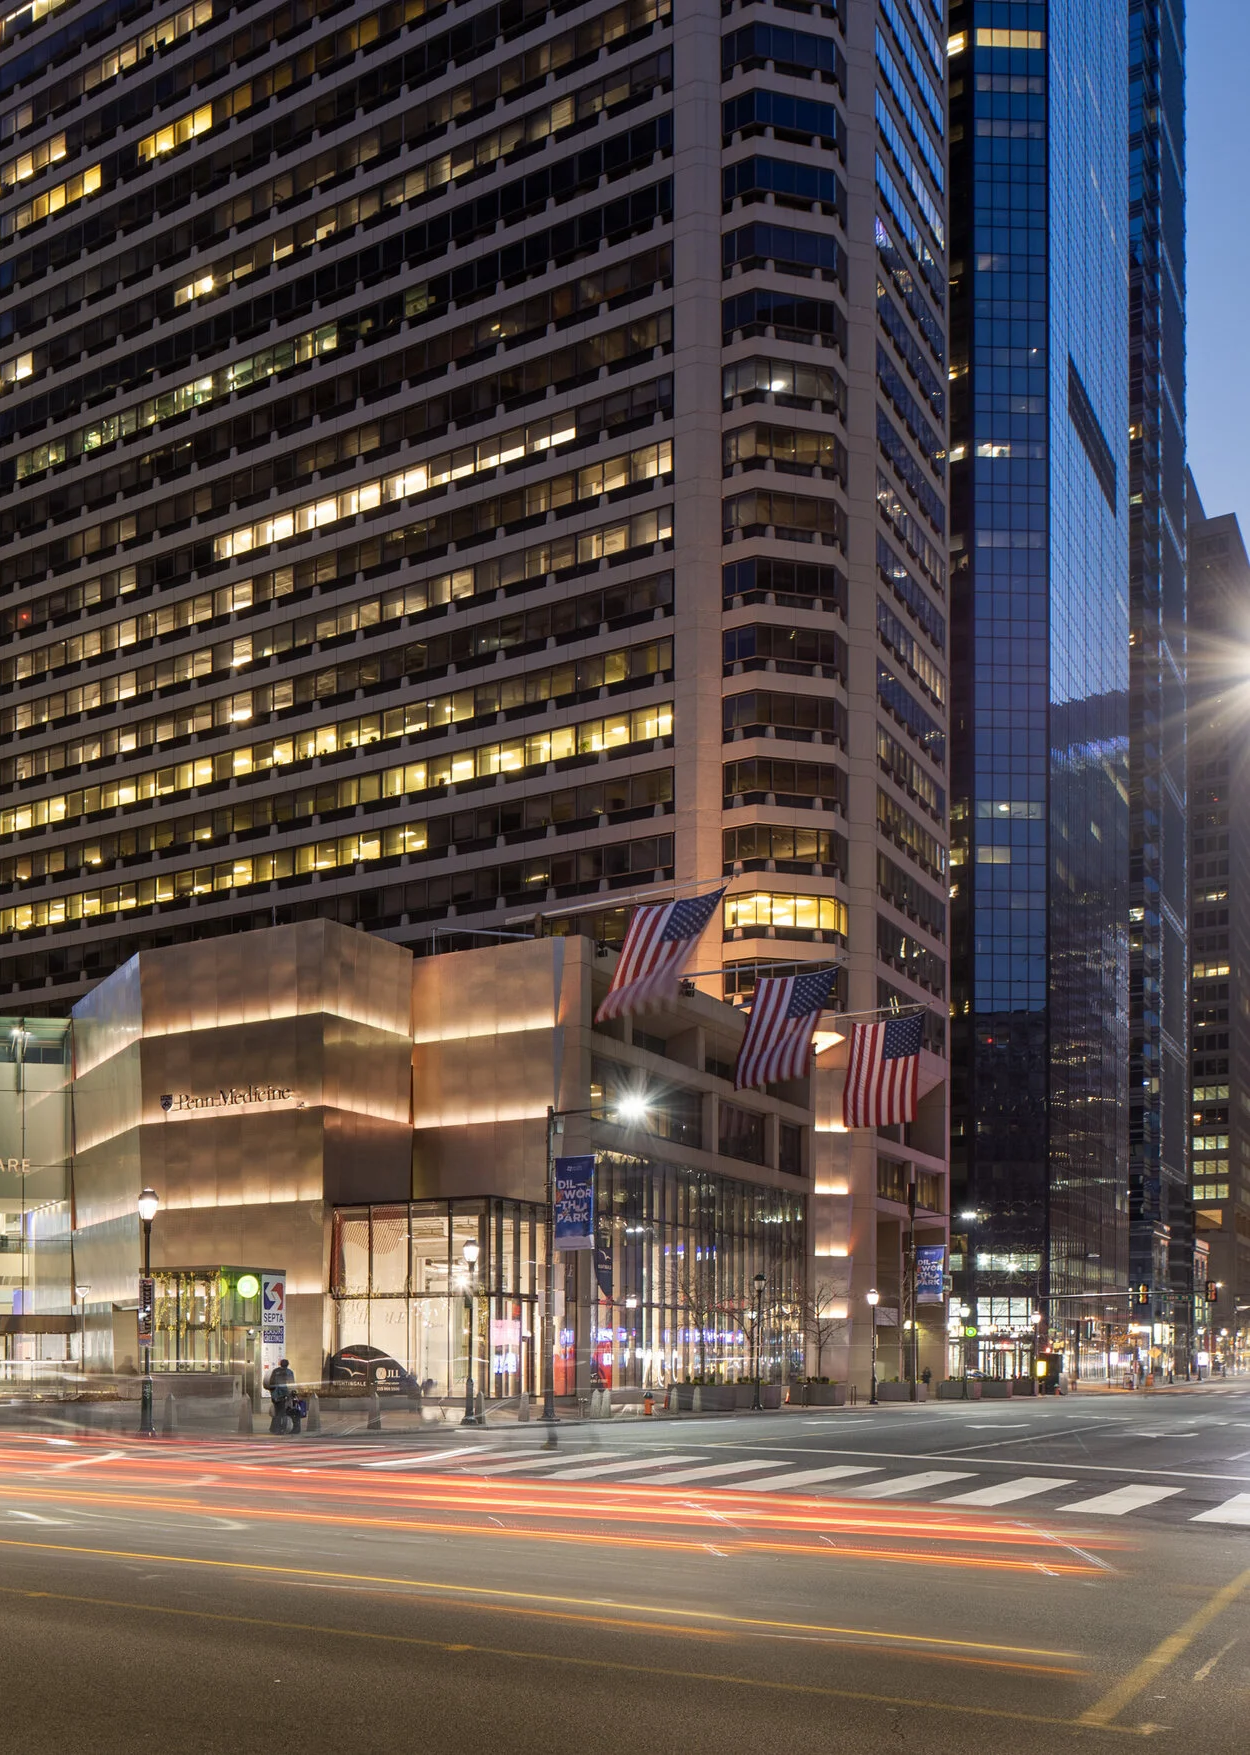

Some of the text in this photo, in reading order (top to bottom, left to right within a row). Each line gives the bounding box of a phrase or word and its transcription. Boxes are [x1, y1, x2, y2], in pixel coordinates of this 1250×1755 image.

[178, 1085, 291, 1110] Penn Medicine
[557, 1212, 589, 1223] PARK
[263, 1313, 284, 1322] SEPTA
